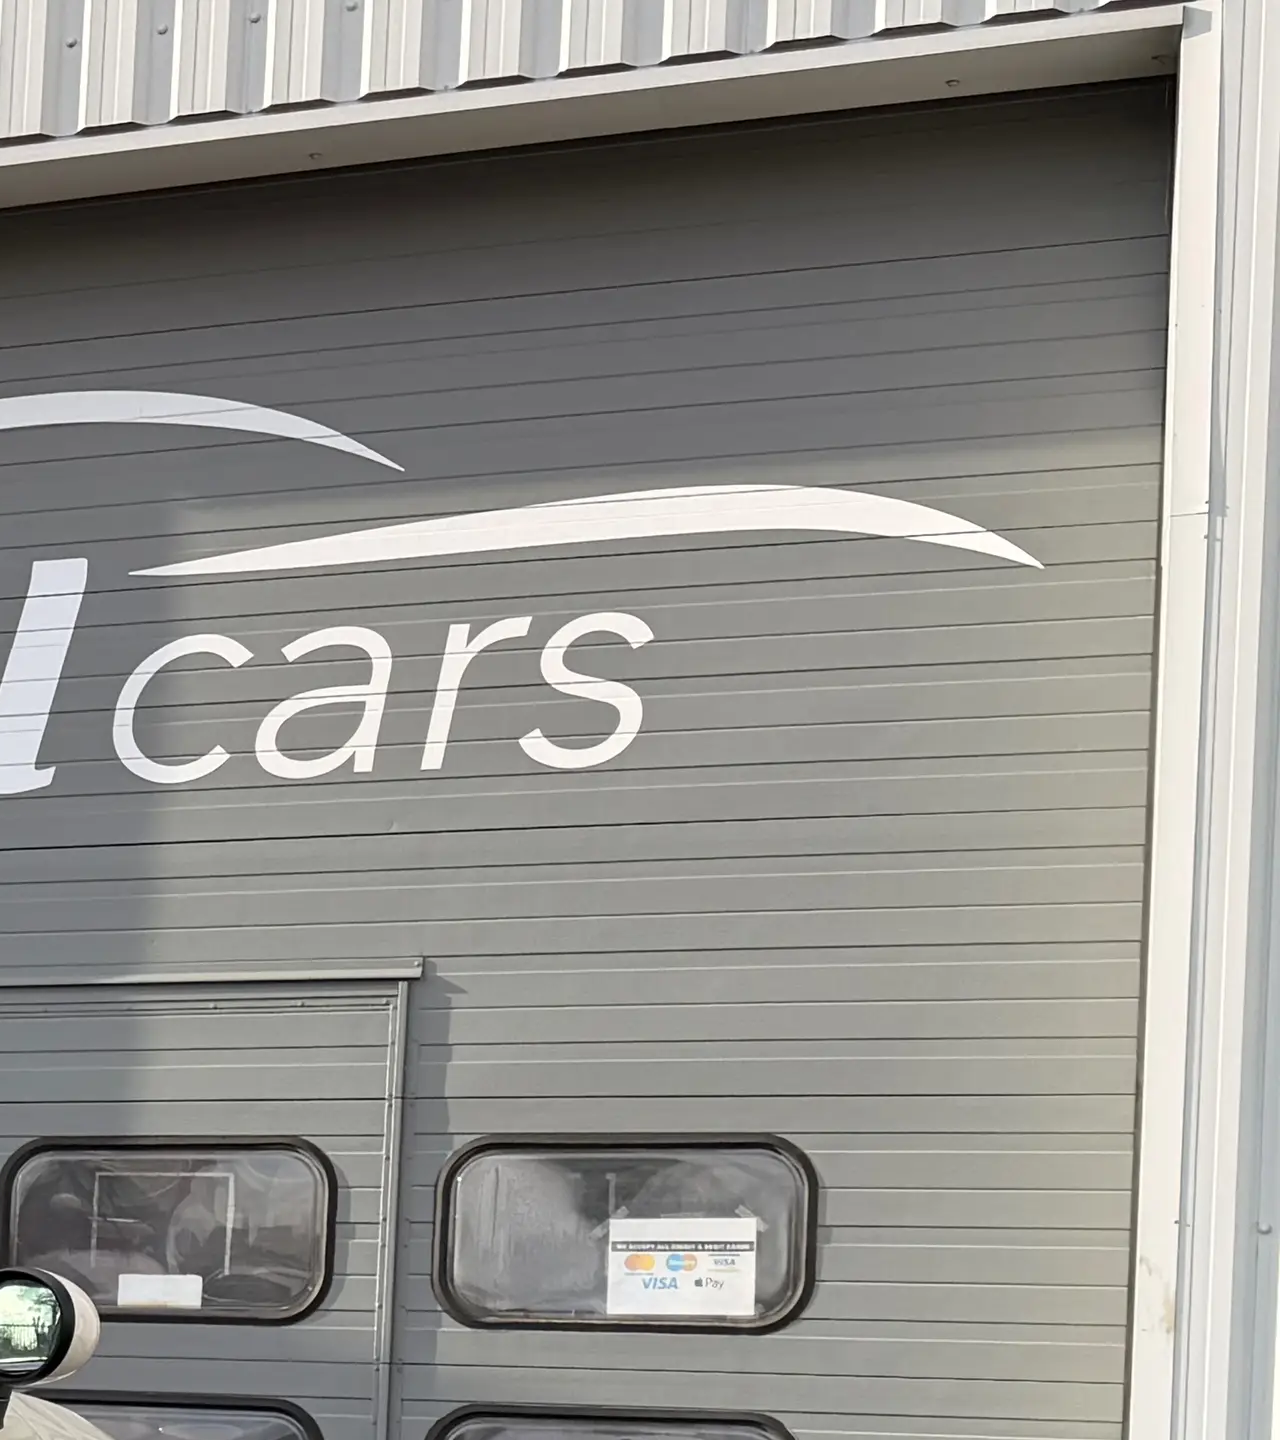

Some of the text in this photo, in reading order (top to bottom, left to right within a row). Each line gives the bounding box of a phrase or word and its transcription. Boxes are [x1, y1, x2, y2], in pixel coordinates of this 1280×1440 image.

[111, 611, 656, 783] cars
[642, 1277, 679, 1290] VISA
[705, 1278, 725, 1290] Pay
